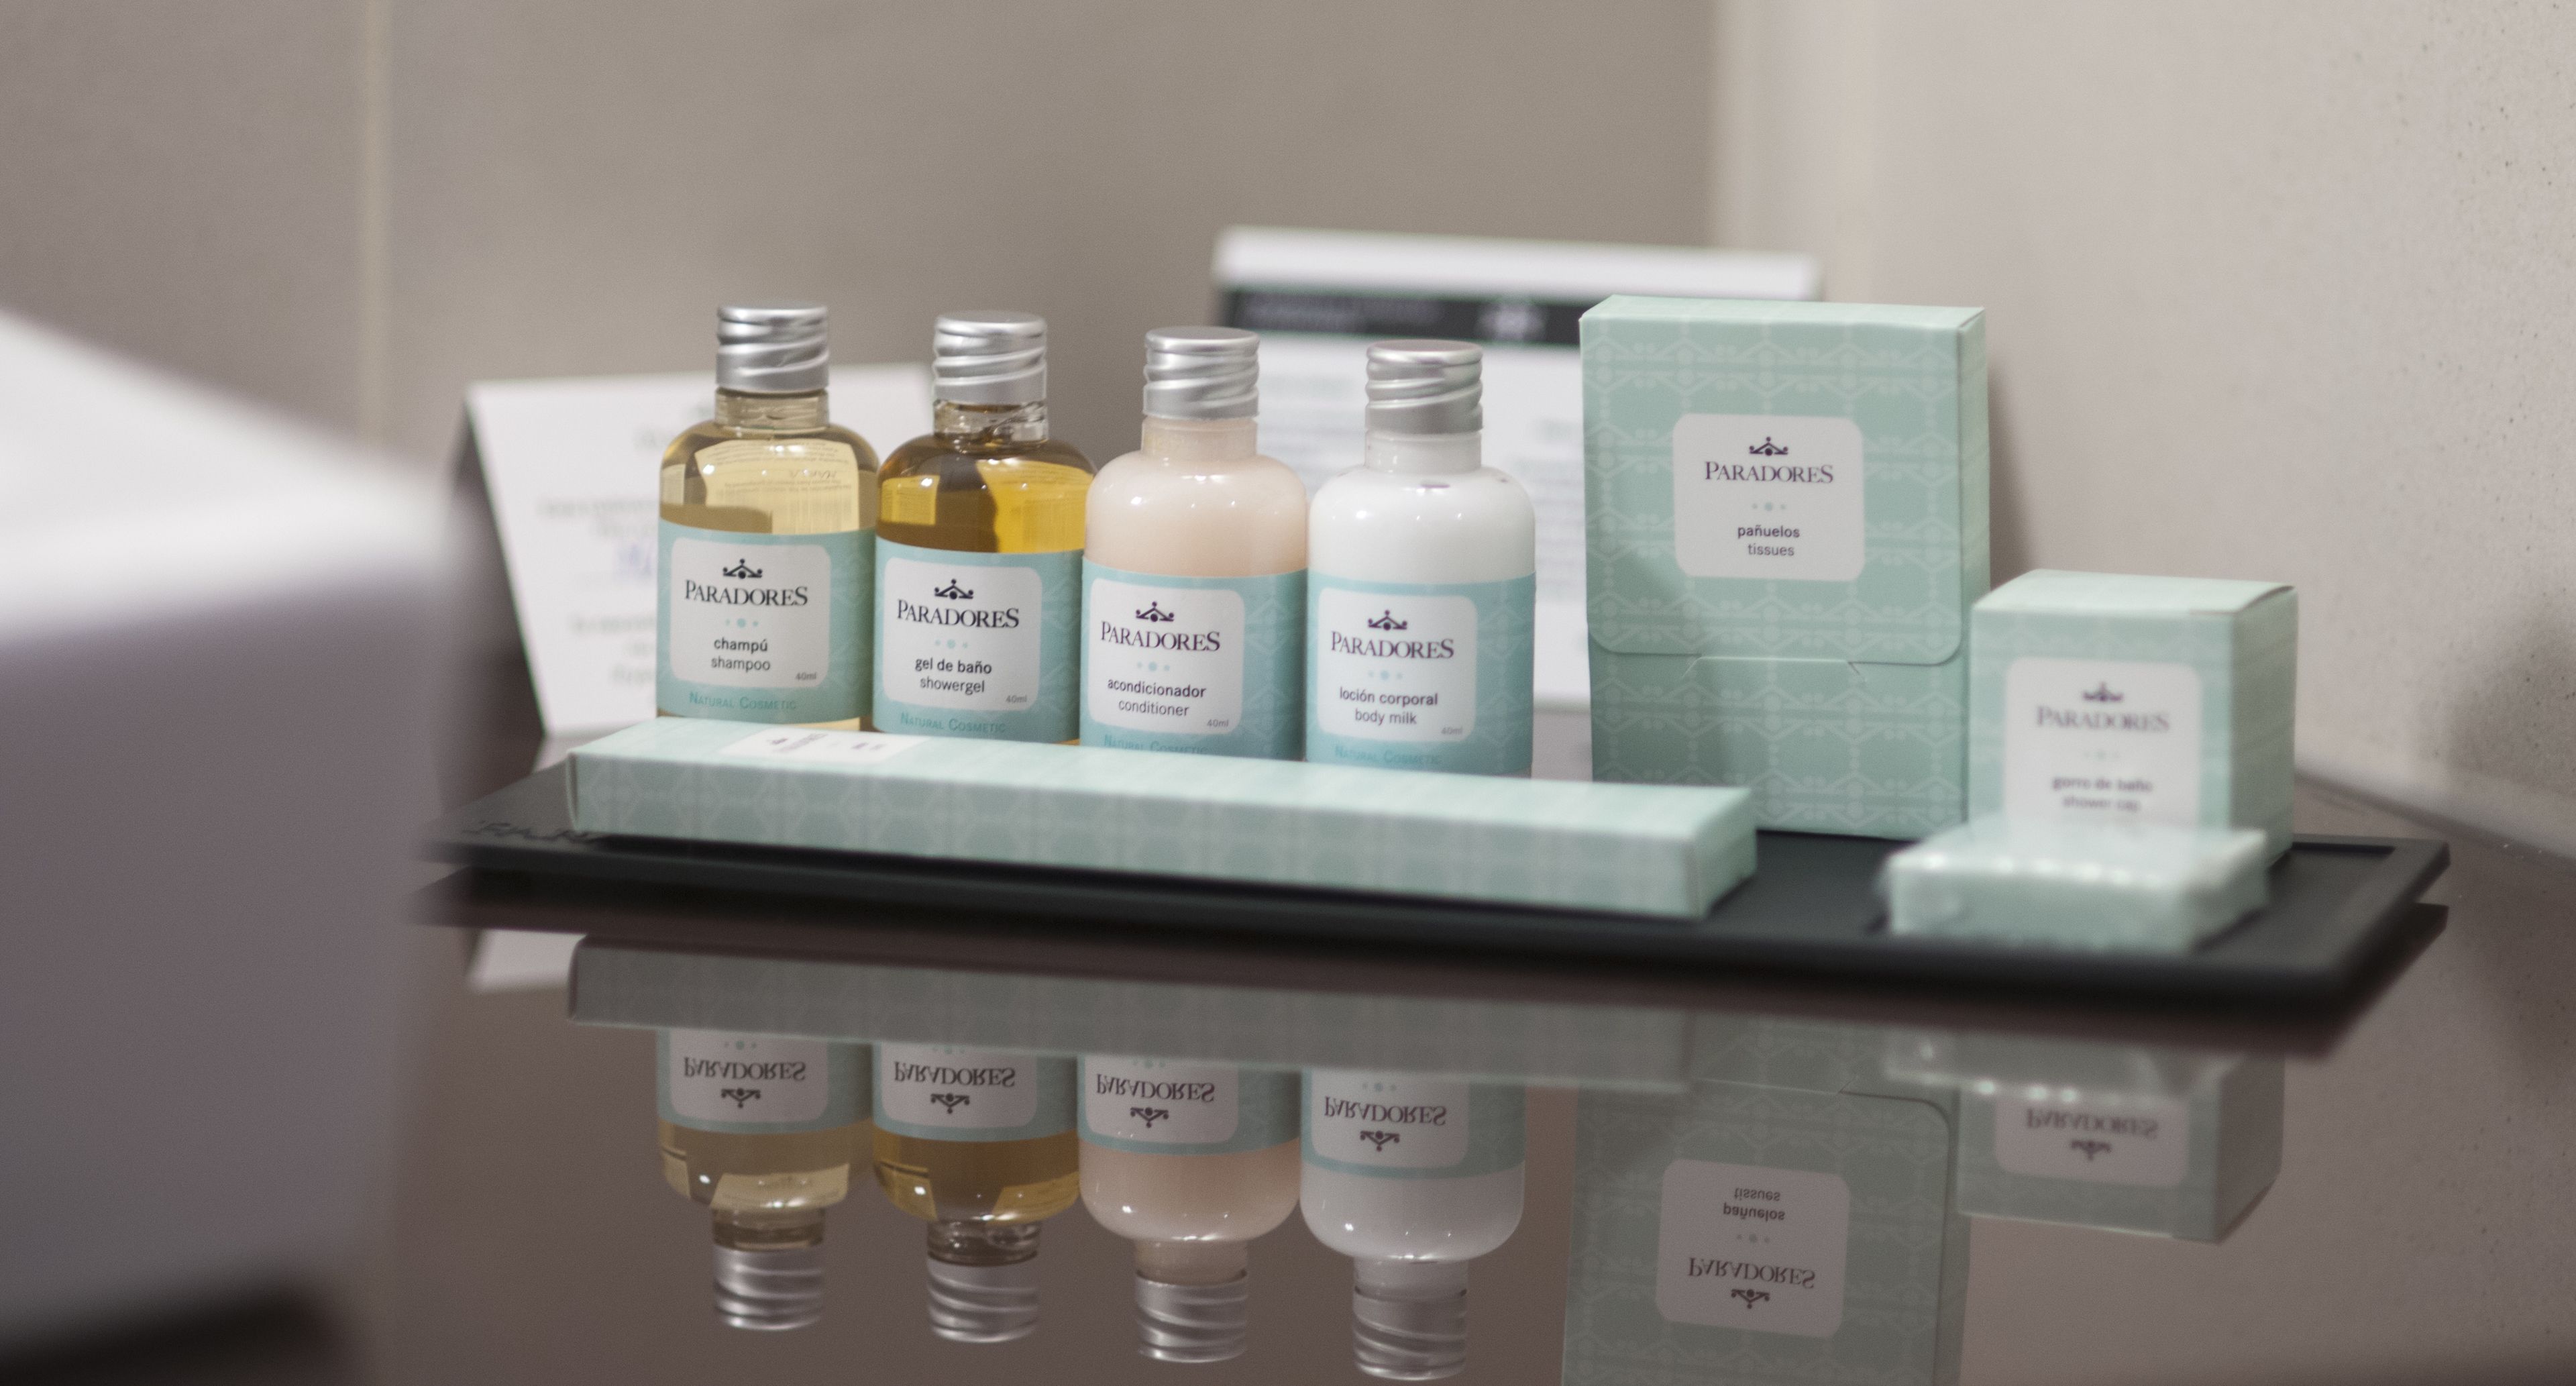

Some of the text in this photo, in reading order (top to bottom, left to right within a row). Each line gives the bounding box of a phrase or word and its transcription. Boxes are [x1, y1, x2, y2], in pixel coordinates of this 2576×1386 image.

[1705, 461, 1834, 484] PARADORES
[1737, 524, 1801, 539] pañuelos
[1747, 543, 1795, 557] tissues
[685, 580, 808, 607] PARADORES
[897, 599, 1020, 629] PARADORES
[1100, 621, 1221, 652] PARADORES
[1331, 631, 1456, 660] PARADORES
[713, 638, 769, 654] champú
[711, 656, 771, 673] shampoo
[914, 657, 993, 675] gel de baño
[920, 676, 986, 696] showergel
[1107, 678, 1208, 699] acondicionador
[1006, 694, 1028, 704] 40ml
[1339, 686, 1439, 708] loción corporal
[1118, 700, 1190, 718] conditioner
[1354, 708, 1417, 726] body milk
[1207, 718, 1229, 729] 40ml
